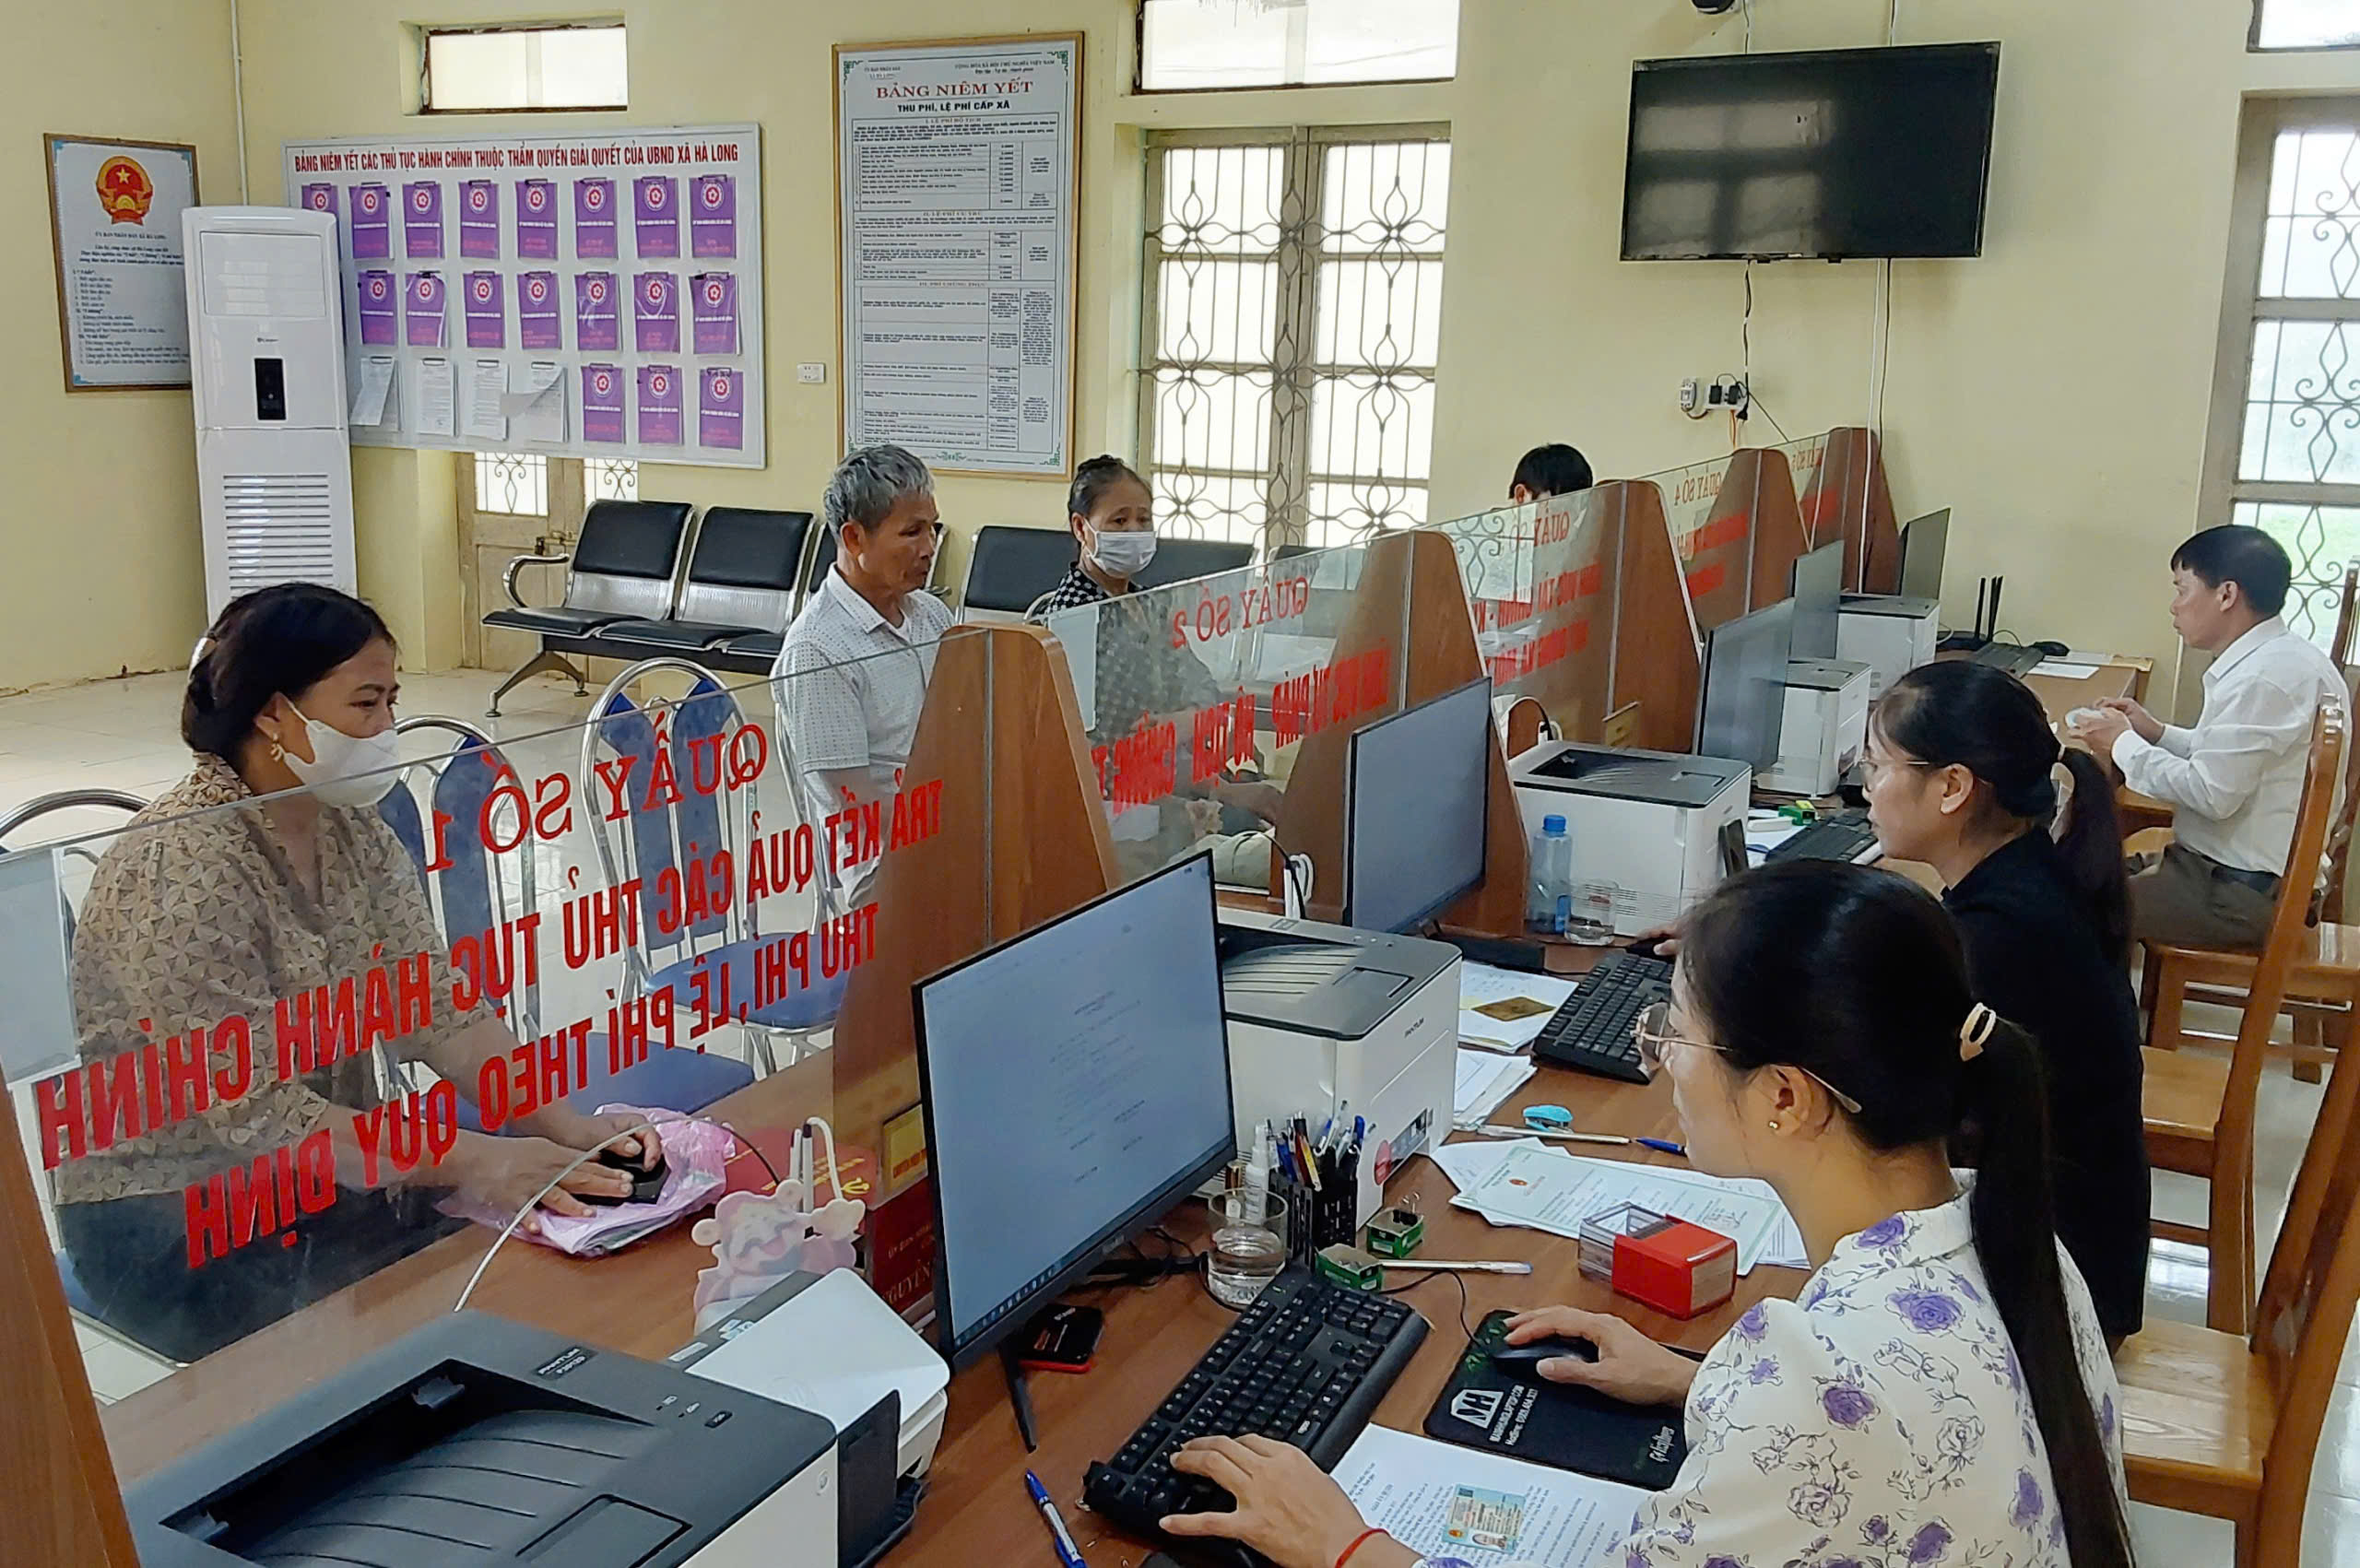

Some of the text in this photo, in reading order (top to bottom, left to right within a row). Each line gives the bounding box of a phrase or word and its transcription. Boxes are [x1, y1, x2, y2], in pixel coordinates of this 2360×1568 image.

[877, 77, 1033, 100] BẢNG NIÊM YẾT
[897, 103, 915, 112] THU
[939, 101, 951, 112] LỆ
[954, 100, 972, 111] PHÍ
[974, 99, 994, 111] CẤP
[997, 98, 1010, 110] XÃ
[295, 149, 319, 172] BẢNG
[320, 151, 342, 171] NIÊM
[344, 148, 359, 171] YẾT
[361, 150, 378, 171] CÁC
[380, 147, 396, 170] THỦ
[399, 152, 416, 172] TỤC
[419, 147, 442, 170] HÀNH
[445, 147, 473, 169] CHÍNH
[475, 147, 504, 171] THUỘC
[507, 140, 535, 168] THẨM
[570, 143, 589, 167] GIẢI
[592, 141, 621, 169] QUYẾT
[624, 139, 644, 166] CỦA
[646, 146, 674, 165] UBND
[678, 141, 691, 163] XÃ
[711, 144, 738, 162] LONG
